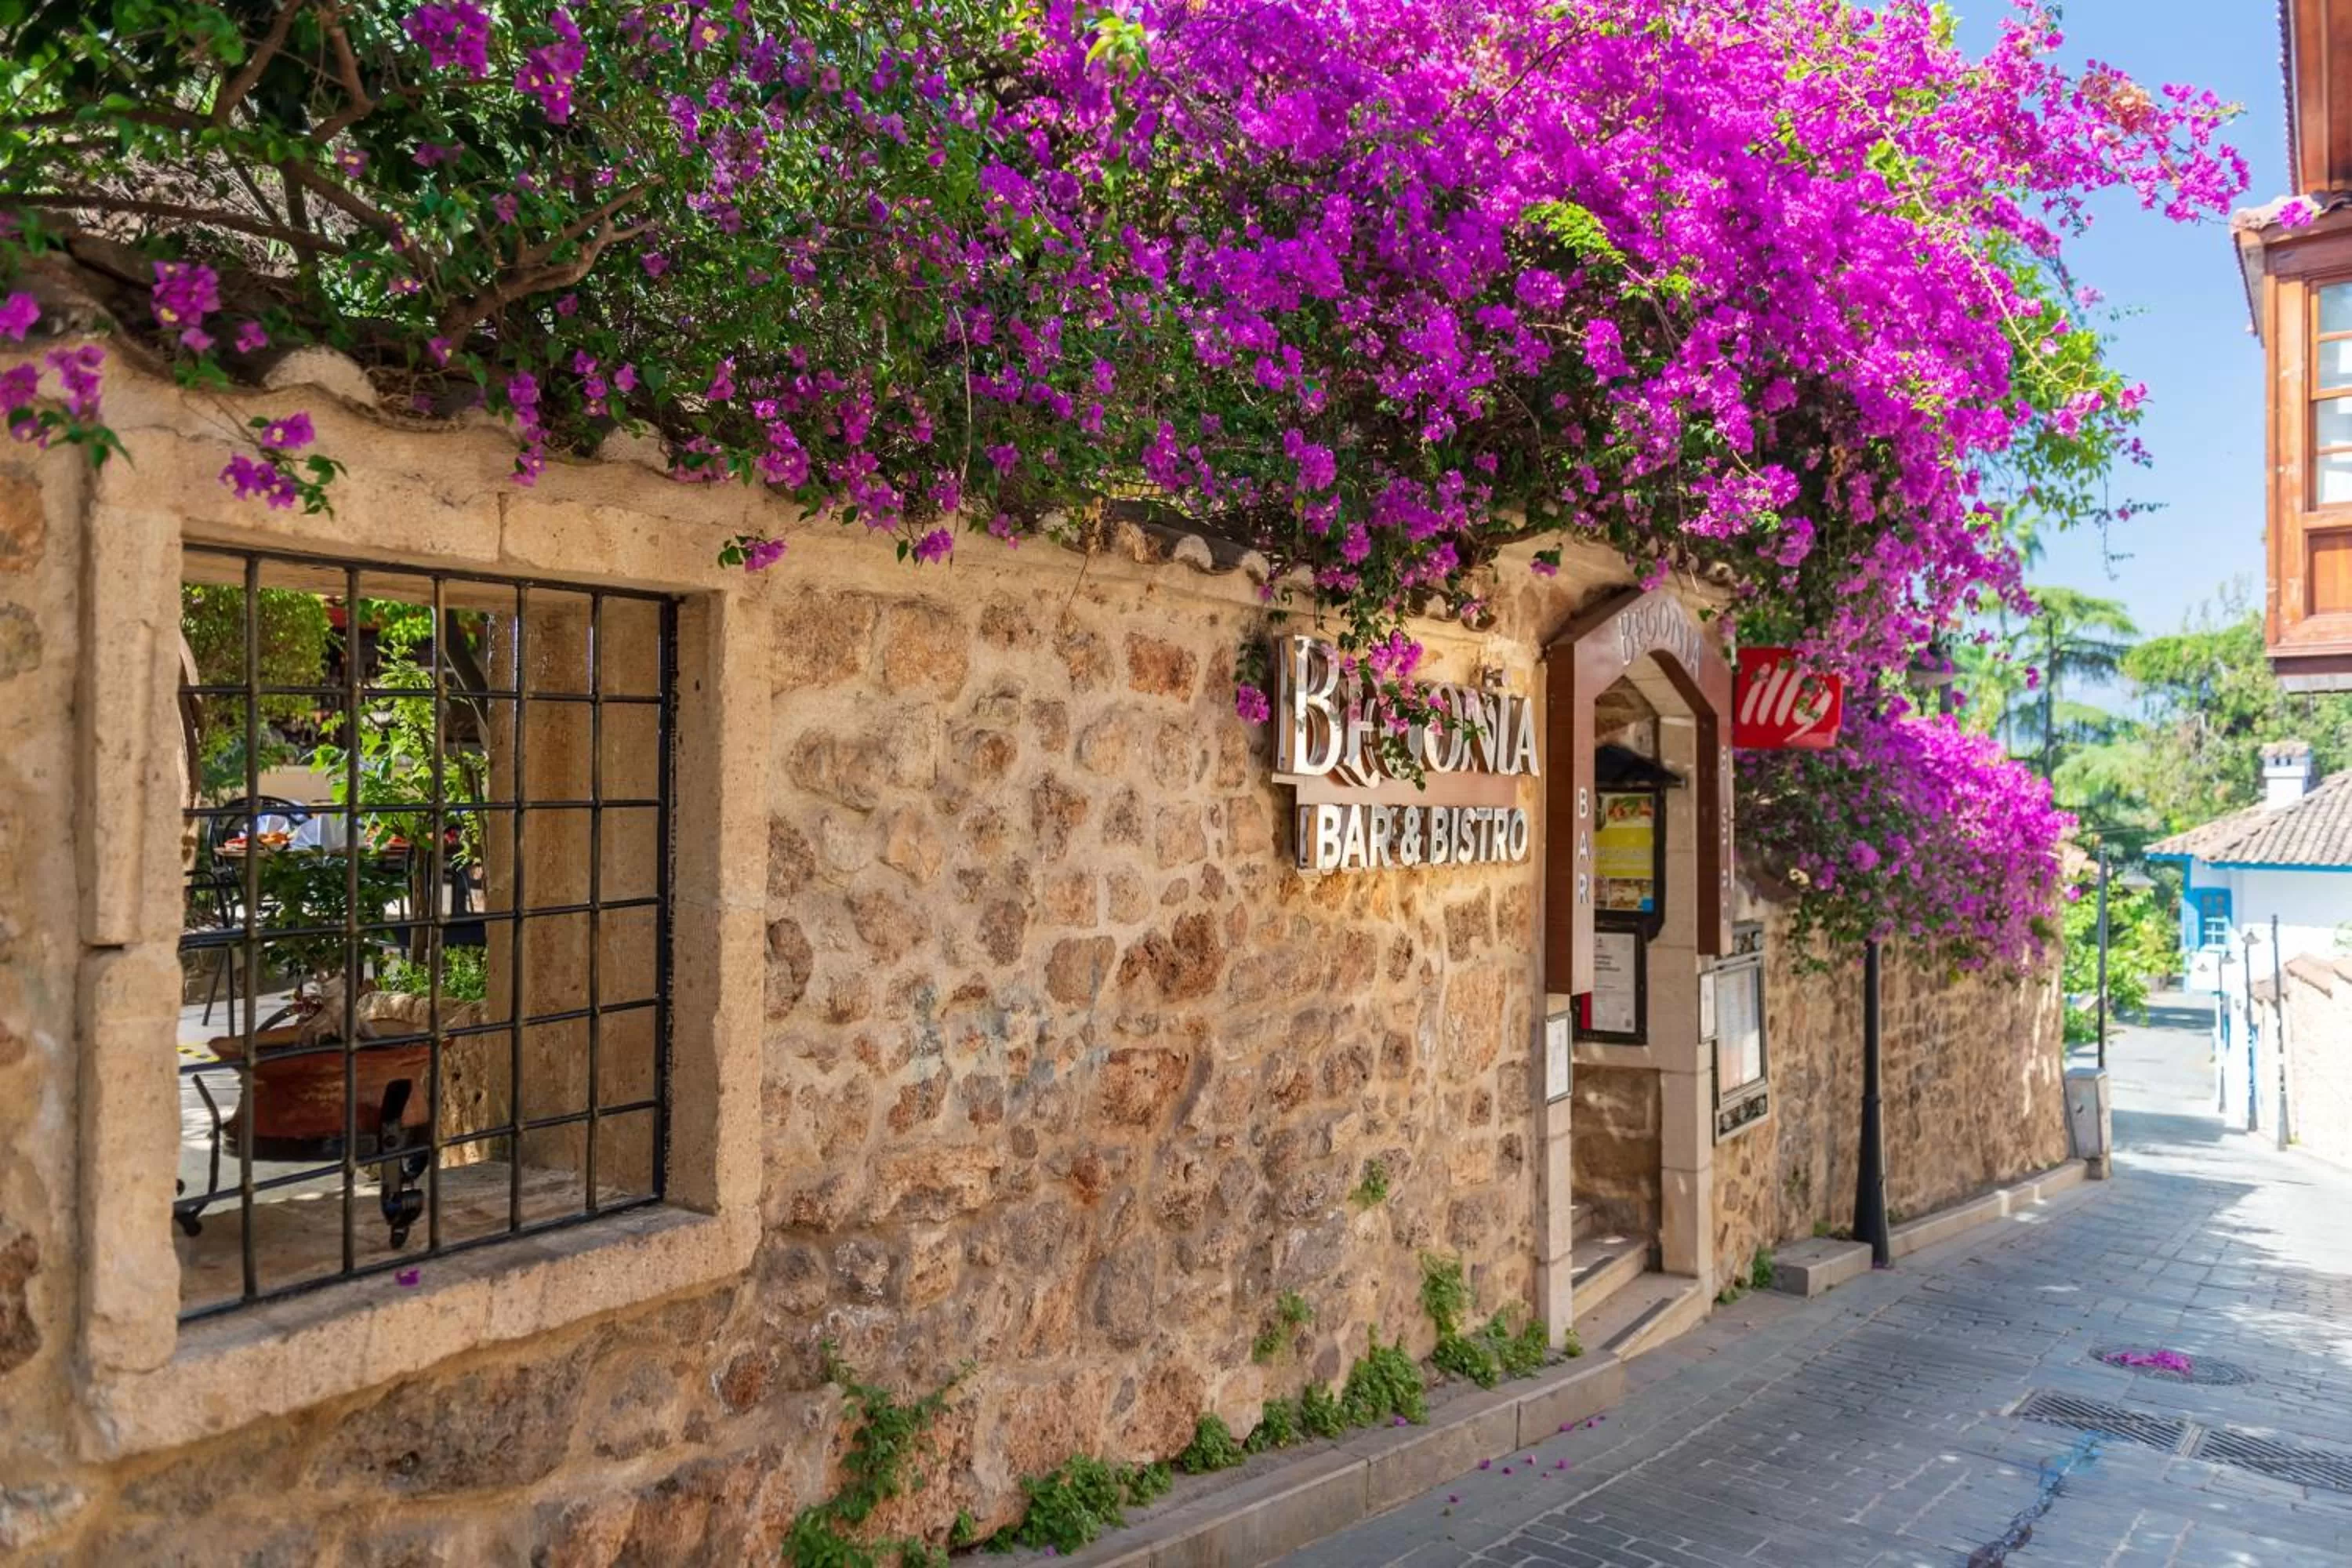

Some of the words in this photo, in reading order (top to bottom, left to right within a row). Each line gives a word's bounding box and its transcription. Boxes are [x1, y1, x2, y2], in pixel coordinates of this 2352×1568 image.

[1739, 655, 1834, 742] illy
[1316, 804, 1393, 869] BAR
[1400, 804, 1421, 866] &
[1428, 807, 1530, 864] BISTRO
[1578, 787, 1591, 904] BAR
